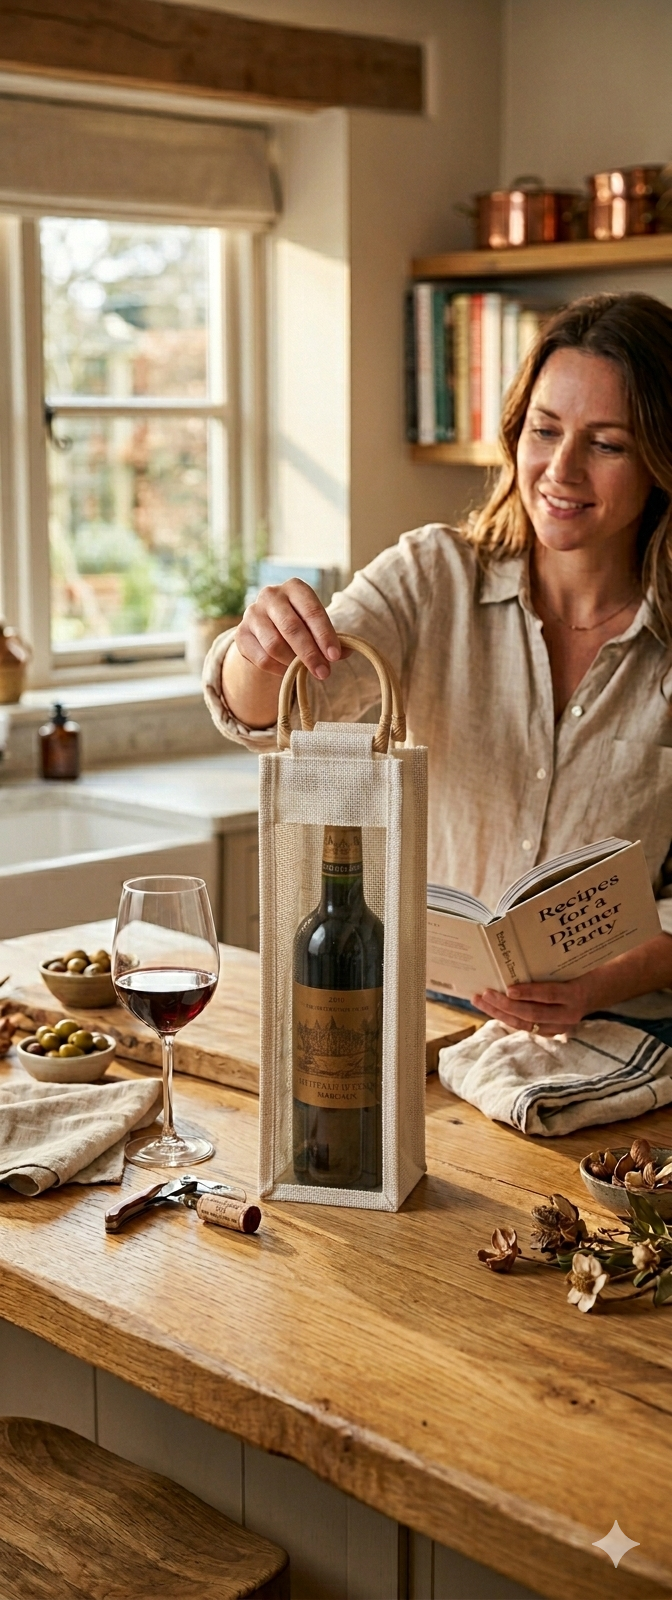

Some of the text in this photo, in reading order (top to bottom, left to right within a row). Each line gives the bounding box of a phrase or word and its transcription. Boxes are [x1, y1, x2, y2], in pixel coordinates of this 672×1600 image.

[538, 875, 619, 923] Recipes
[558, 897, 607, 926] for a
[549, 903, 622, 946] Dinner
[562, 919, 618, 954] Party
